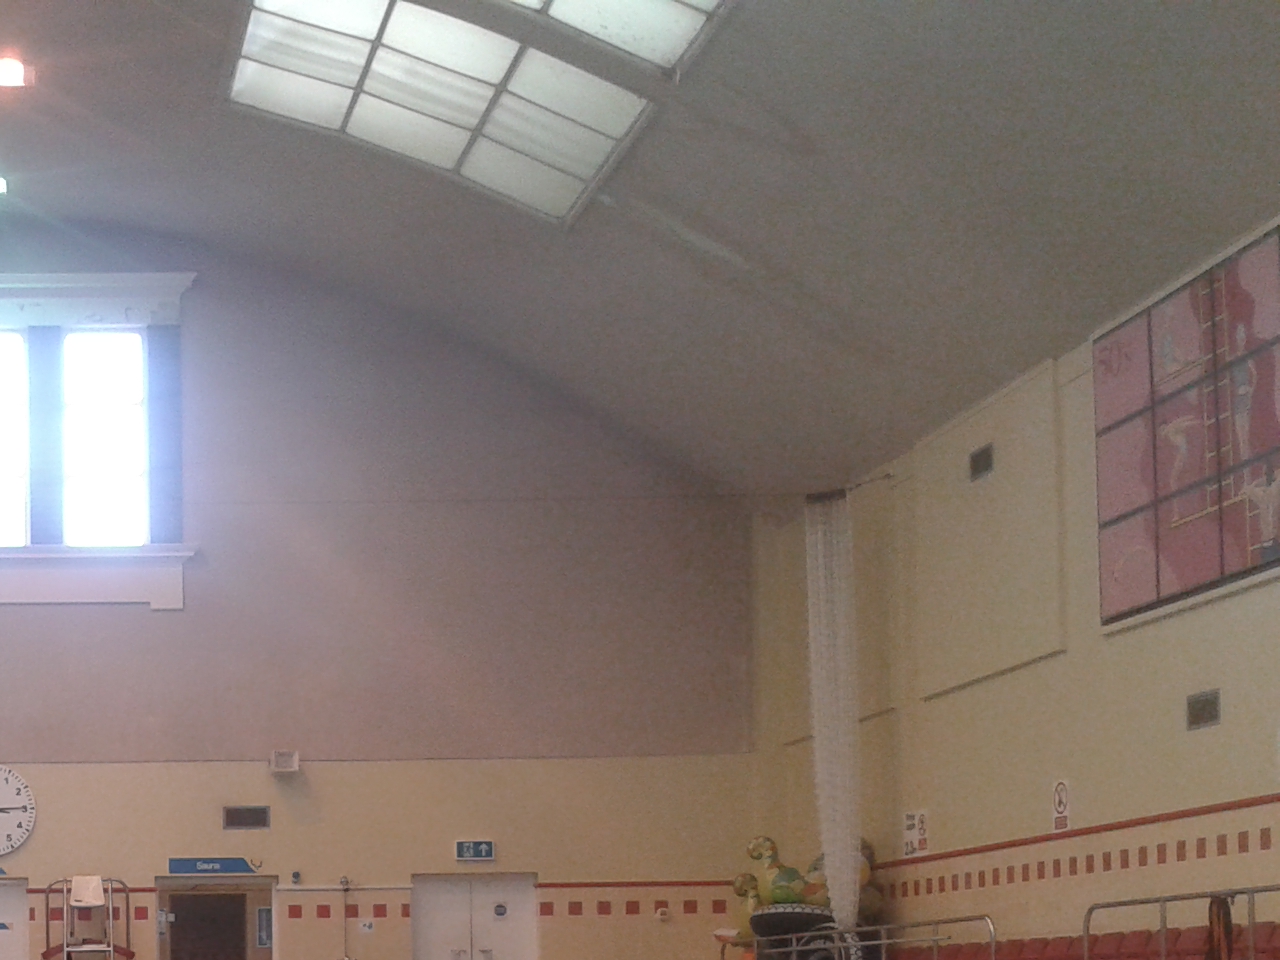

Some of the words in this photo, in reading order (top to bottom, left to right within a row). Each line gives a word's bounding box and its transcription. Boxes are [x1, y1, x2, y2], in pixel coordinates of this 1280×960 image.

[15, 787, 22, 796] 2
[21, 805, 28, 813] 3
[16, 821, 23, 829] 4
[6, 833, 12, 842] 5
[196, 861, 220, 871] Sauna
